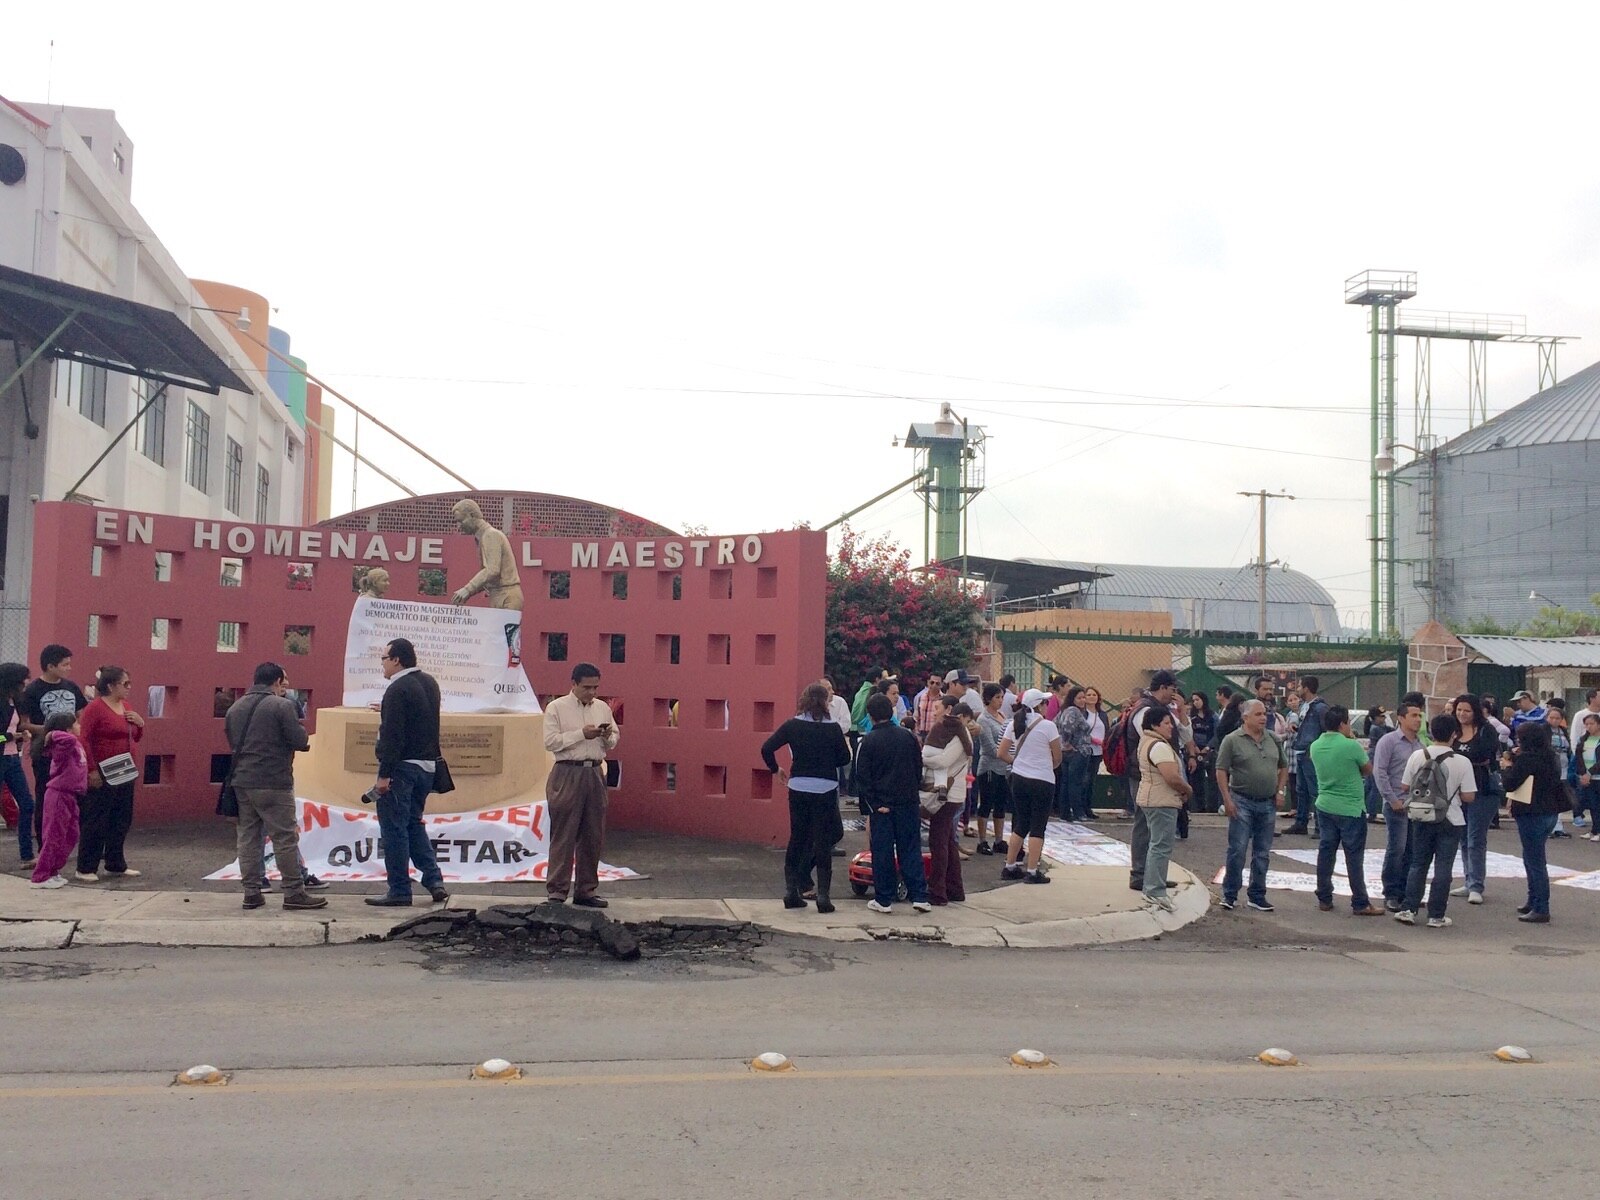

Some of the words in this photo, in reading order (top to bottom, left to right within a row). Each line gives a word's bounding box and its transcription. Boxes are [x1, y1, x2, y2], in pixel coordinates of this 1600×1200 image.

[96, 510, 154, 544] EN
[194, 520, 444, 564] HOMENAJE
[571, 535, 763, 568] MAESTRO
[370, 601, 419, 612] MOVIMIENTO
[400, 625, 429, 633] REFORMA
[424, 634, 440, 642] PARA
